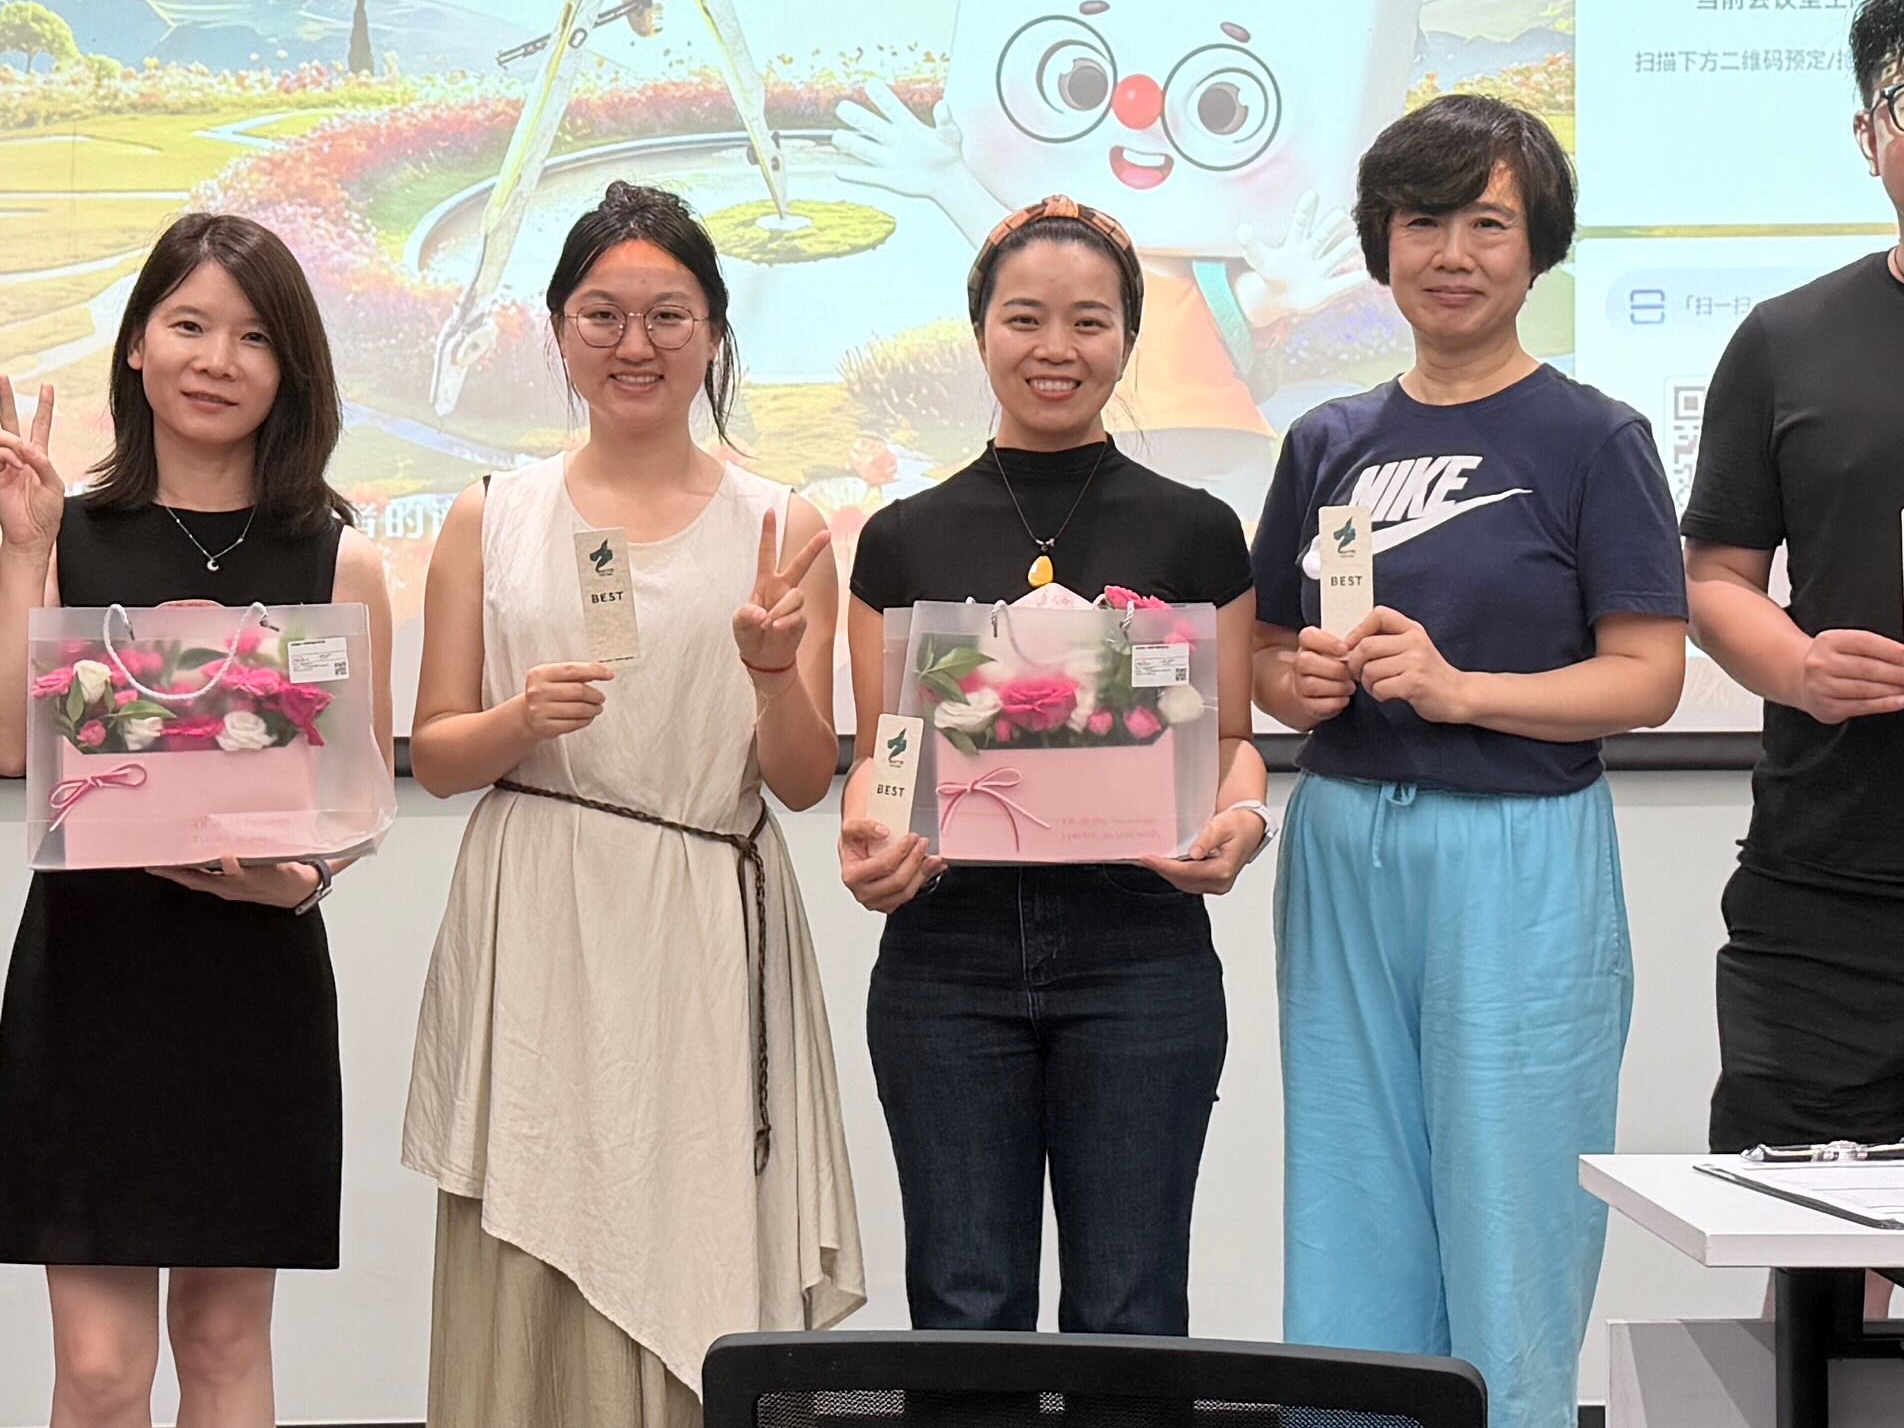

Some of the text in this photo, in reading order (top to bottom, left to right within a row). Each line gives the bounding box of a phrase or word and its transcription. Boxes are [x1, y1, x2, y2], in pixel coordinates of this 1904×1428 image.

[1349, 456, 1483, 522] NIKE
[1330, 575, 1363, 587] BEST
[591, 591, 624, 604] BEST
[877, 784, 905, 797] BEST
